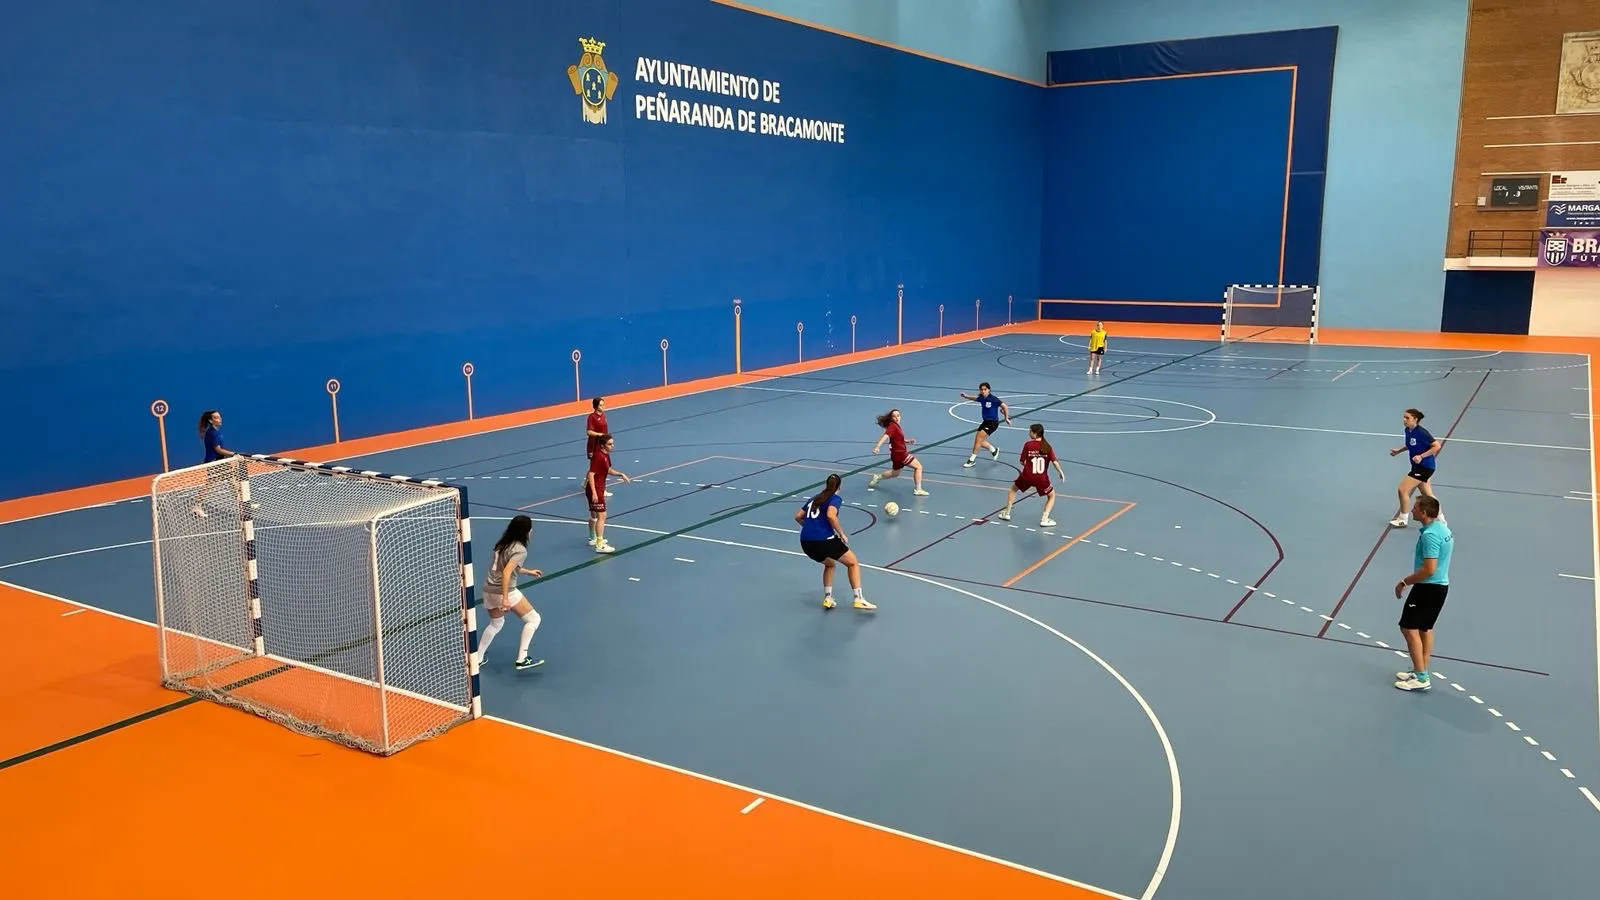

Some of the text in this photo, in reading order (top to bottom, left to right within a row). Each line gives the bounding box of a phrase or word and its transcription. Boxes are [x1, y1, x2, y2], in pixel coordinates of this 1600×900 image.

[635, 56, 781, 104] AYUNTAMIENTO DE
[635, 92, 845, 144] PEÑARANDA DE BRACAMONTE
[155, 405, 165, 413] 12
[1031, 457, 1045, 474] 10
